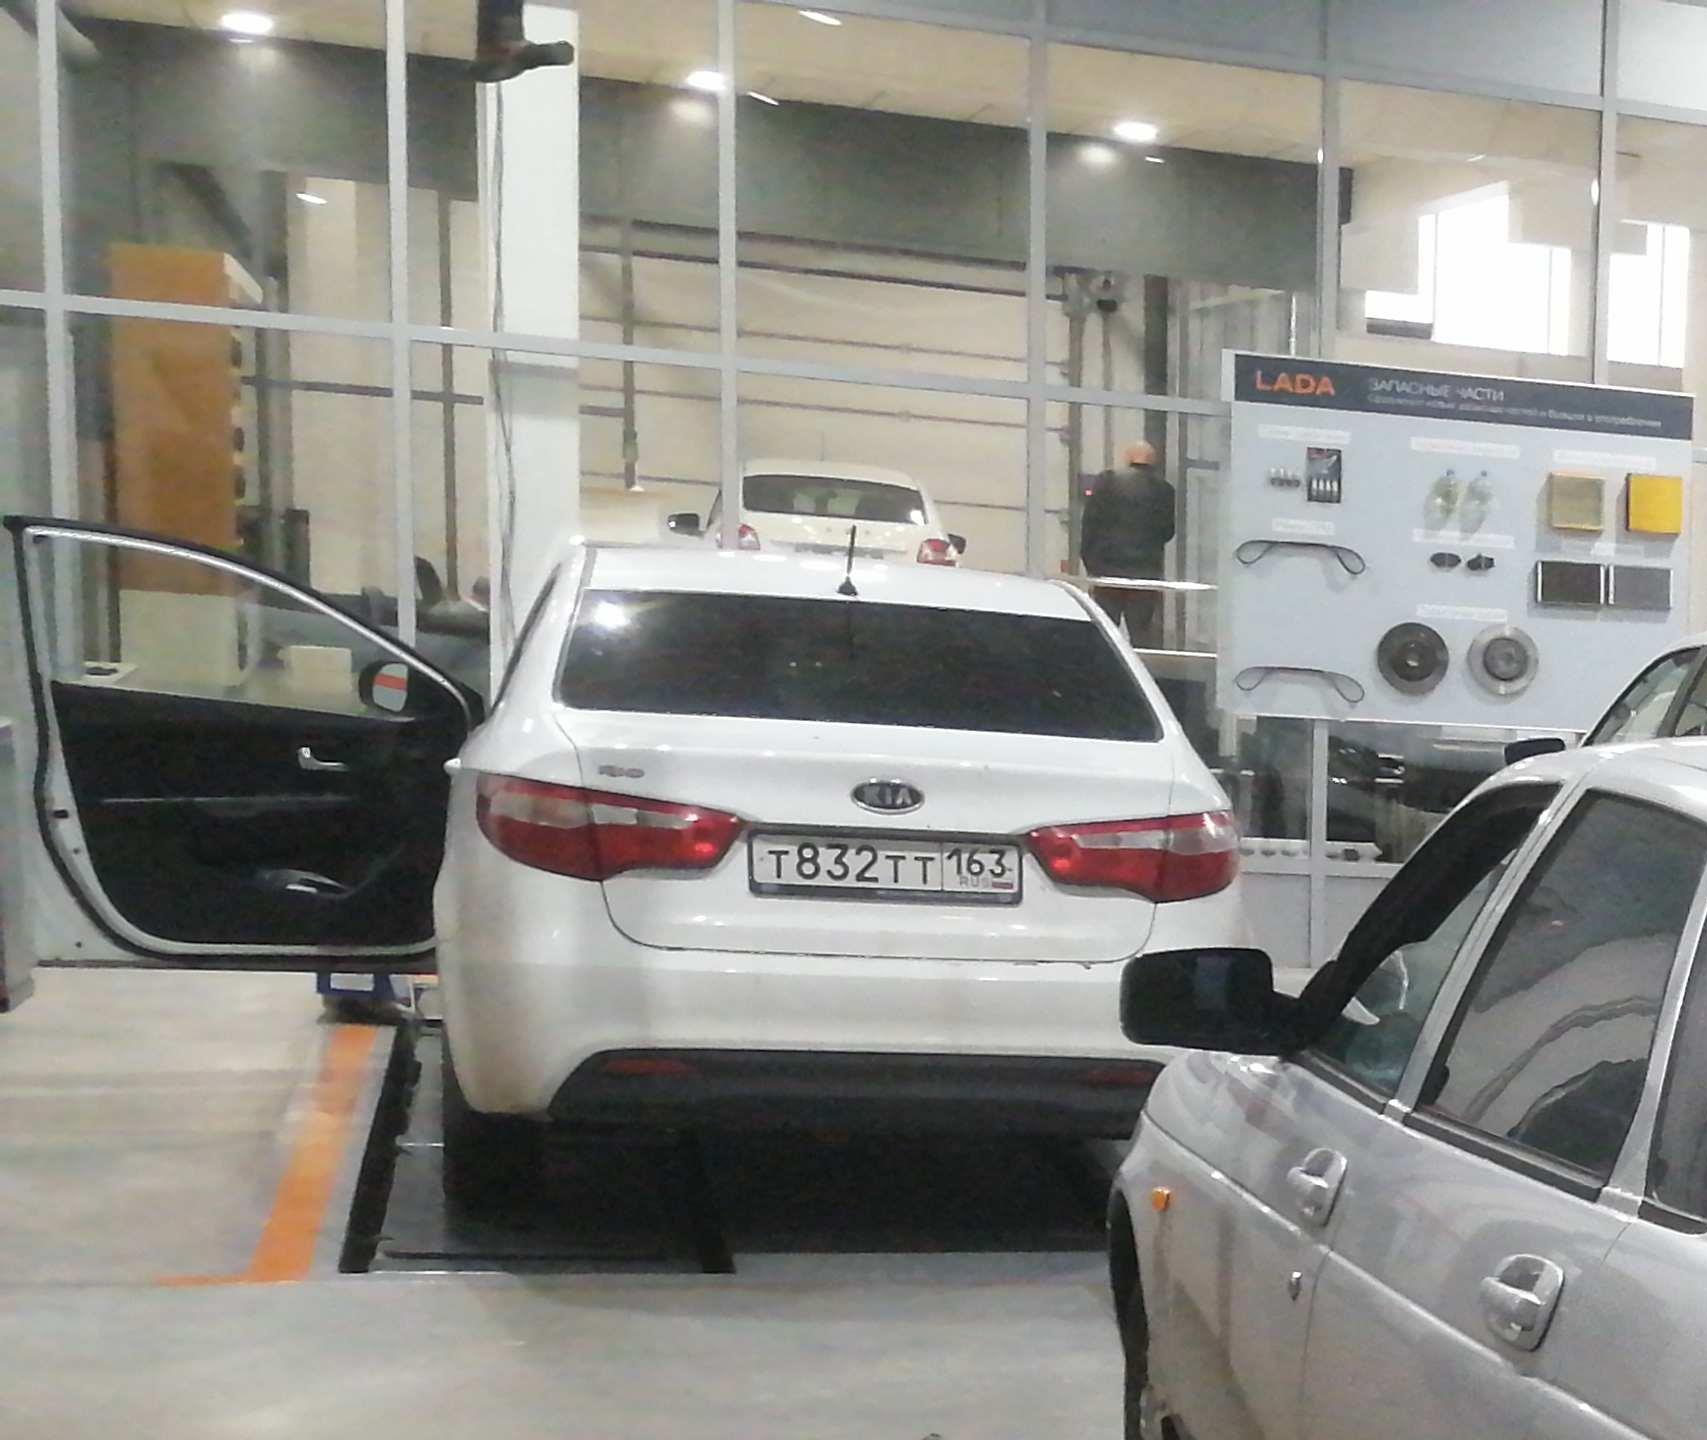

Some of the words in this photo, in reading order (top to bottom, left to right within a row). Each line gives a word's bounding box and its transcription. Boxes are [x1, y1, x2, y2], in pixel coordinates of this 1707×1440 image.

[1255, 369, 1336, 397] LADA
[1368, 377, 1451, 398] ЗАПАСНЫЕ
[1456, 385, 1505, 401] ЧАСТИ
[863, 785, 912, 807] KIA
[946, 848, 1007, 877] 163
[959, 875, 992, 889] RUS
